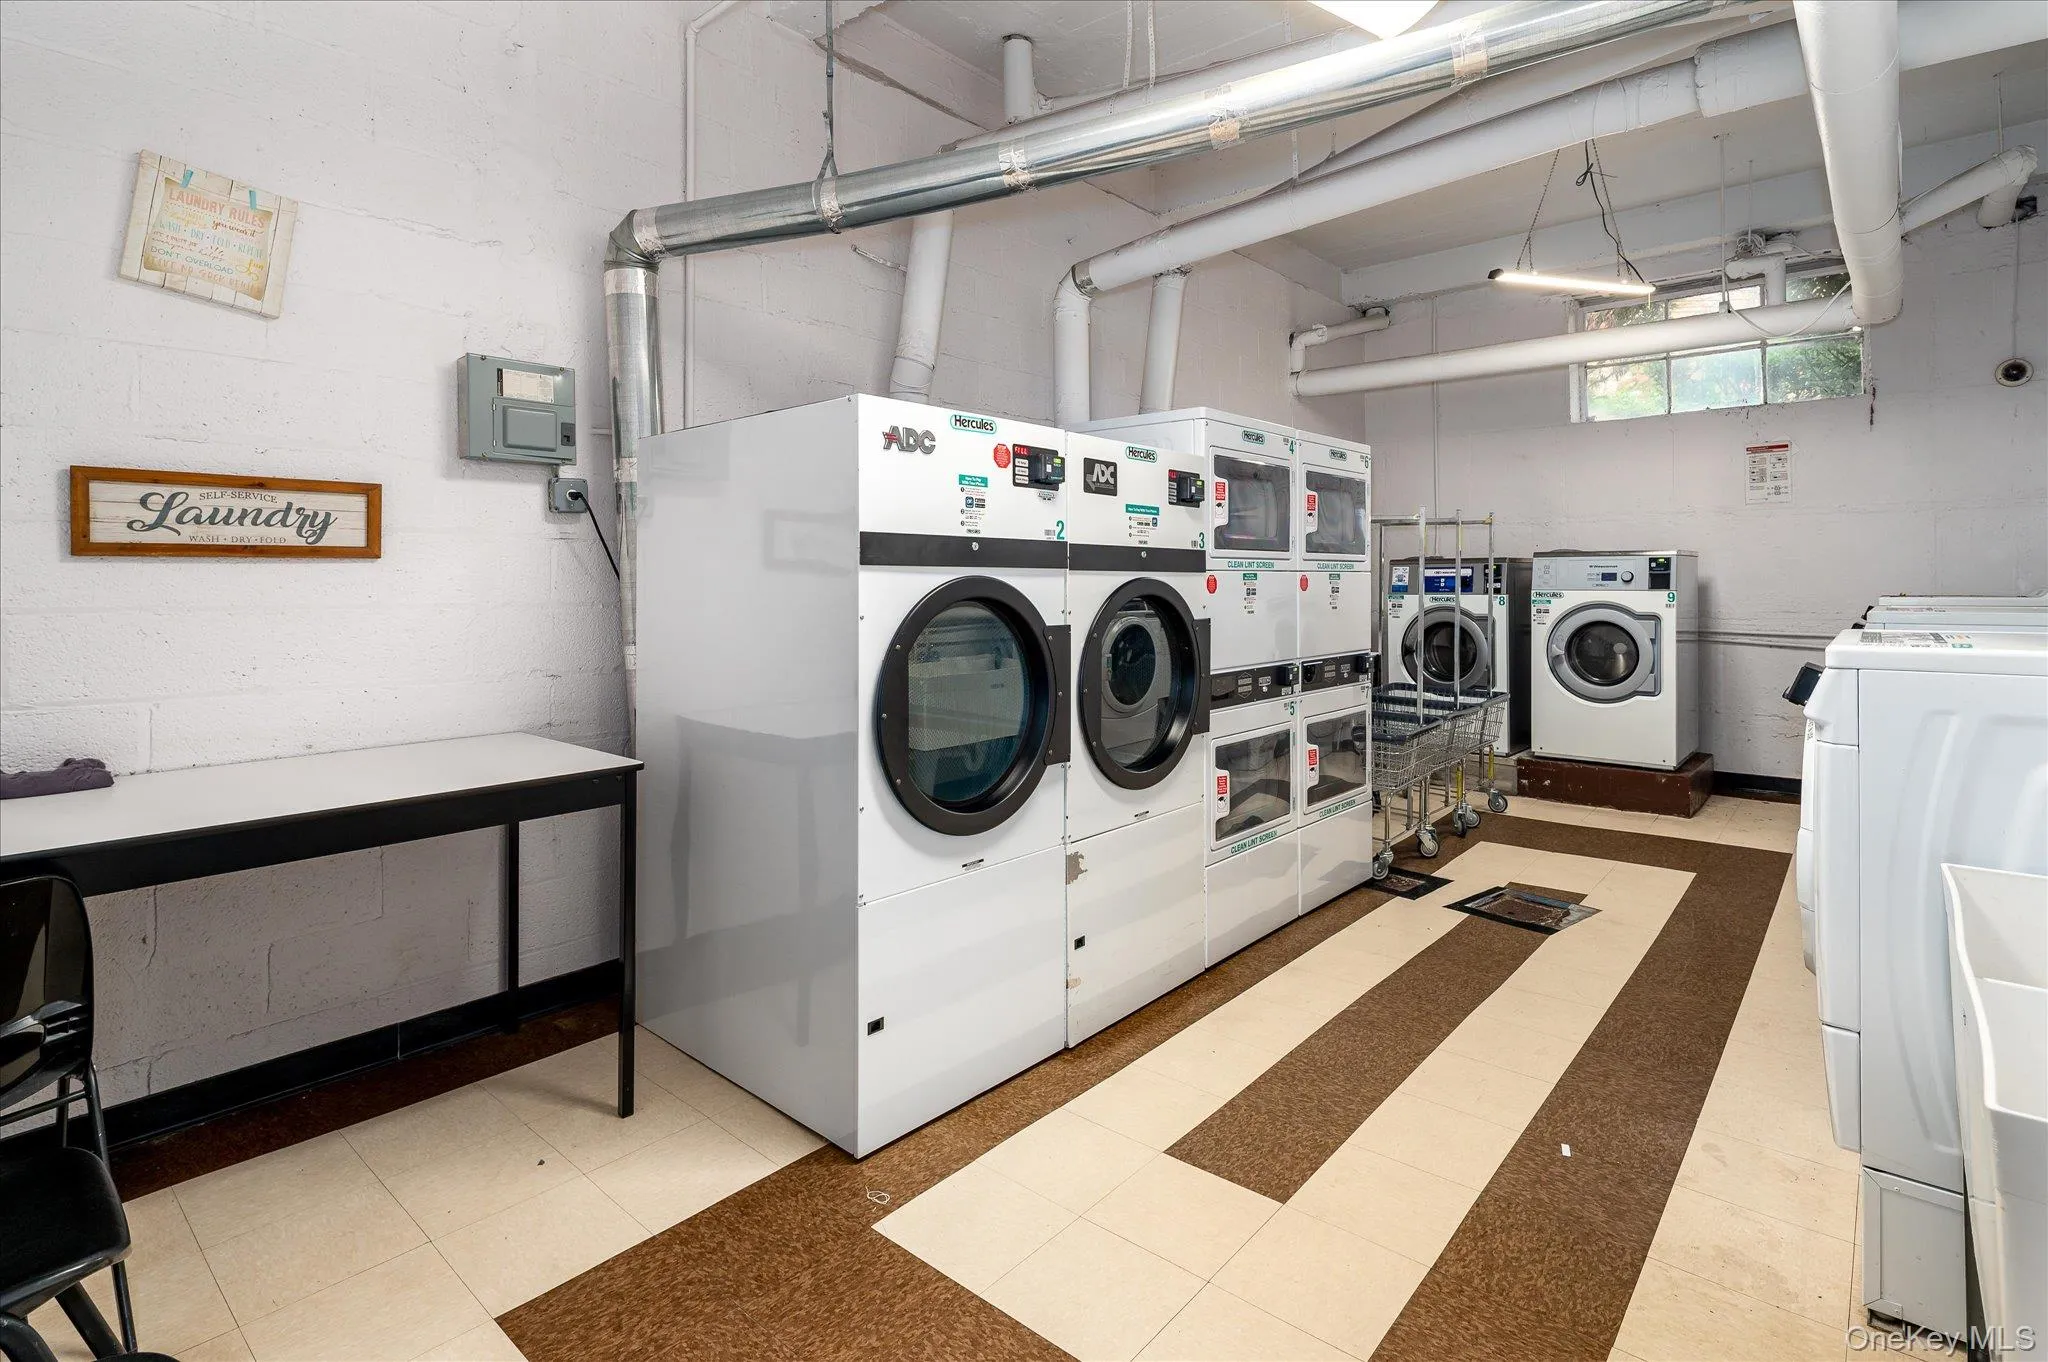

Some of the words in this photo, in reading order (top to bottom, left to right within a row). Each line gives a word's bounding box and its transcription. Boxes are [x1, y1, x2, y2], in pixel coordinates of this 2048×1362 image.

[168, 189, 226, 217] LAUNDRY
[228, 207, 266, 229] RULES
[159, 221, 181, 234] WASH
[190, 229, 204, 241] DRY
[212, 220, 227, 230] you
[151, 246, 182, 259] DON'T
[185, 256, 234, 275] OVERLOAD
[954, 414, 995, 432] Hercules
[882, 425, 937, 455] ADC
[1243, 431, 1264, 444] Hercules
[1014, 446, 1029, 455] FILL
[1128, 446, 1157, 461] Hercules
[1289, 440, 1294, 455] 4
[1364, 455, 1369, 469] 6
[199, 491, 278, 504] SELF-SERVICE
[127, 491, 338, 546] Laundry
[1056, 521, 1065, 540] 2
[189, 534, 220, 544] WASH
[231, 535, 252, 544] DRY
[260, 536, 288, 545] FOLD
[1199, 532, 1205, 549] 3
[1227, 560, 1244, 568] CLEAN
[1245, 561, 1256, 569] LINT
[1256, 561, 1275, 569] SCREEN
[1431, 595, 1456, 603] Hercules
[1498, 596, 1506, 606] 8
[1535, 591, 1563, 599] Hercules
[1667, 592, 1676, 603] 9
[1365, 686, 1370, 699] 7
[1289, 701, 1295, 716] 5
[1319, 807, 1332, 818] CLEAN
[1332, 803, 1342, 813] LINT
[1341, 798, 1356, 810] SCREEN
[1230, 841, 1248, 854] CLEAN
[1248, 837, 1259, 847] LINT
[1258, 829, 1278, 843] SCREEN
